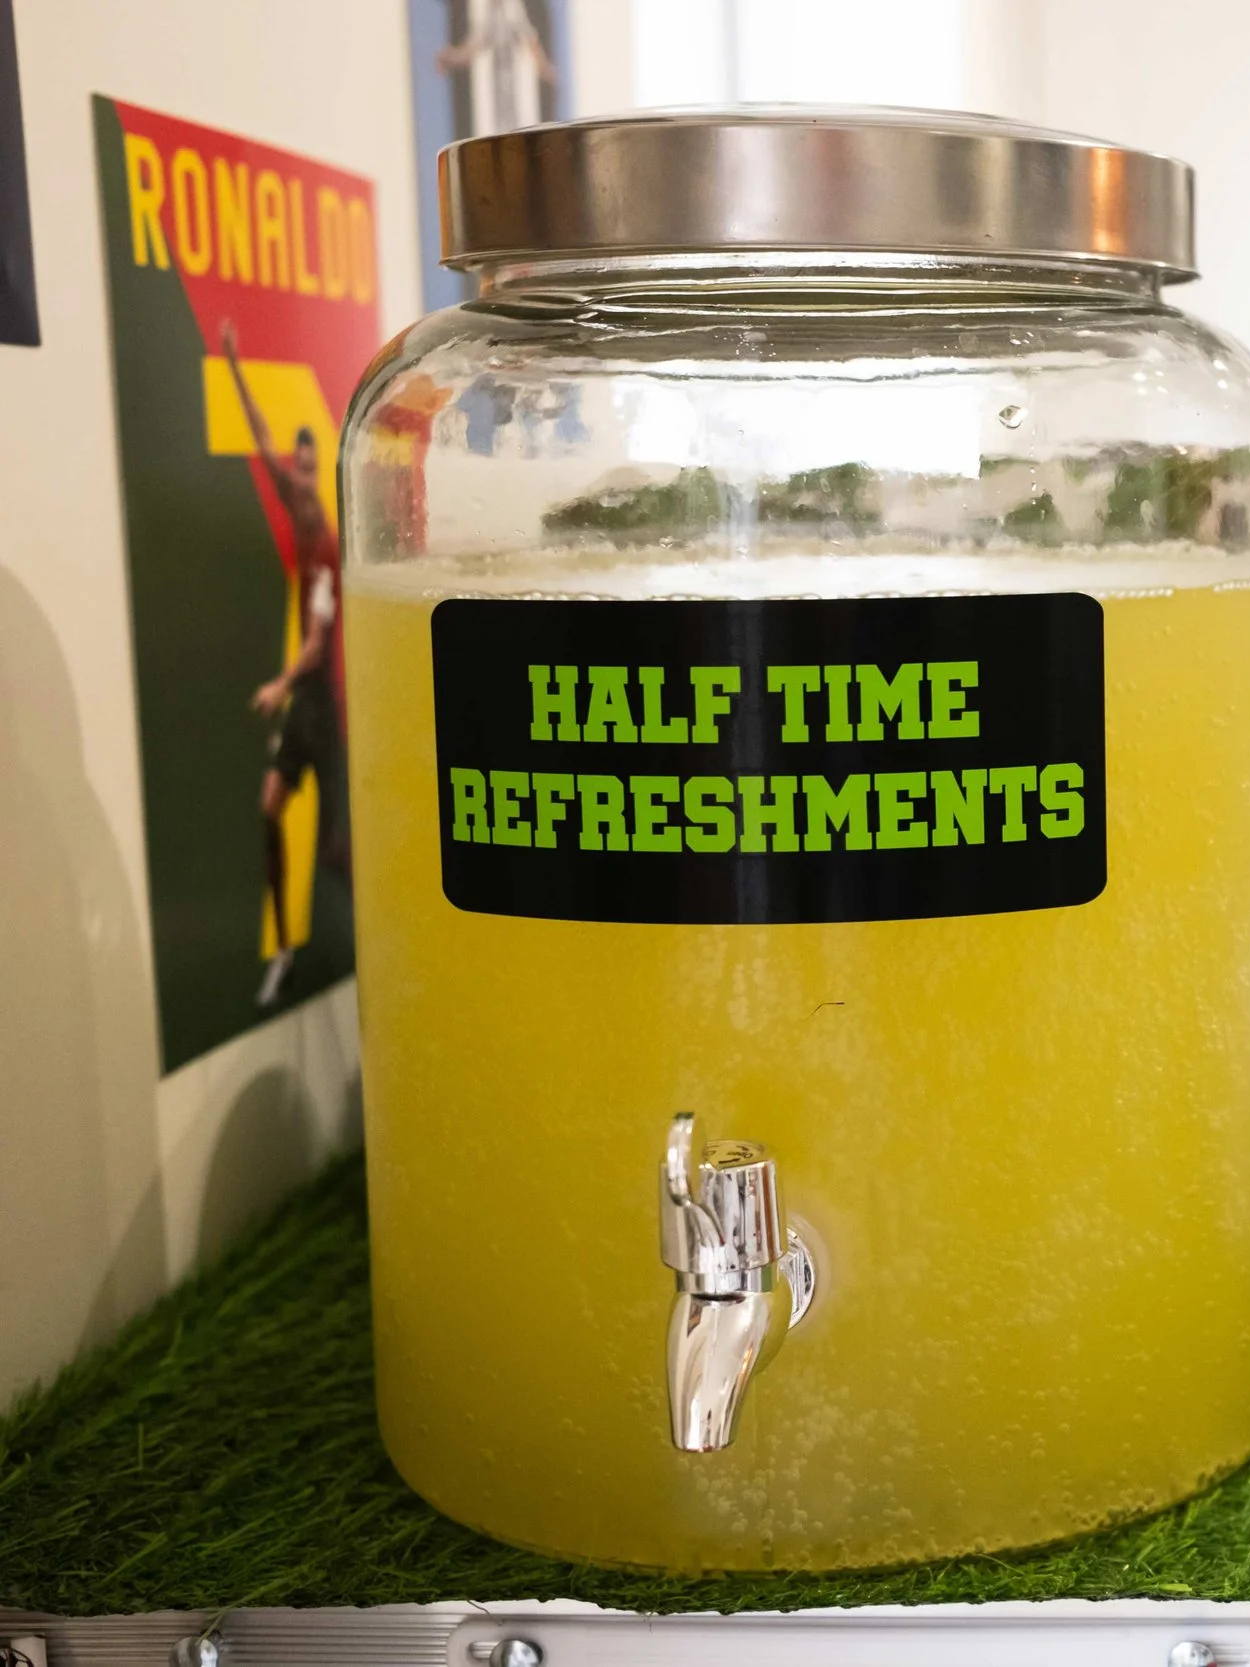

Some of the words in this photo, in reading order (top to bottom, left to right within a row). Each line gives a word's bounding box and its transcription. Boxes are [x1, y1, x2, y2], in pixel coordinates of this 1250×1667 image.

[123, 130, 375, 305] RONALDO
[528, 665, 741, 744] HALF
[767, 660, 980, 743] TIME
[450, 762, 1085, 853] REFRESHMENTS
